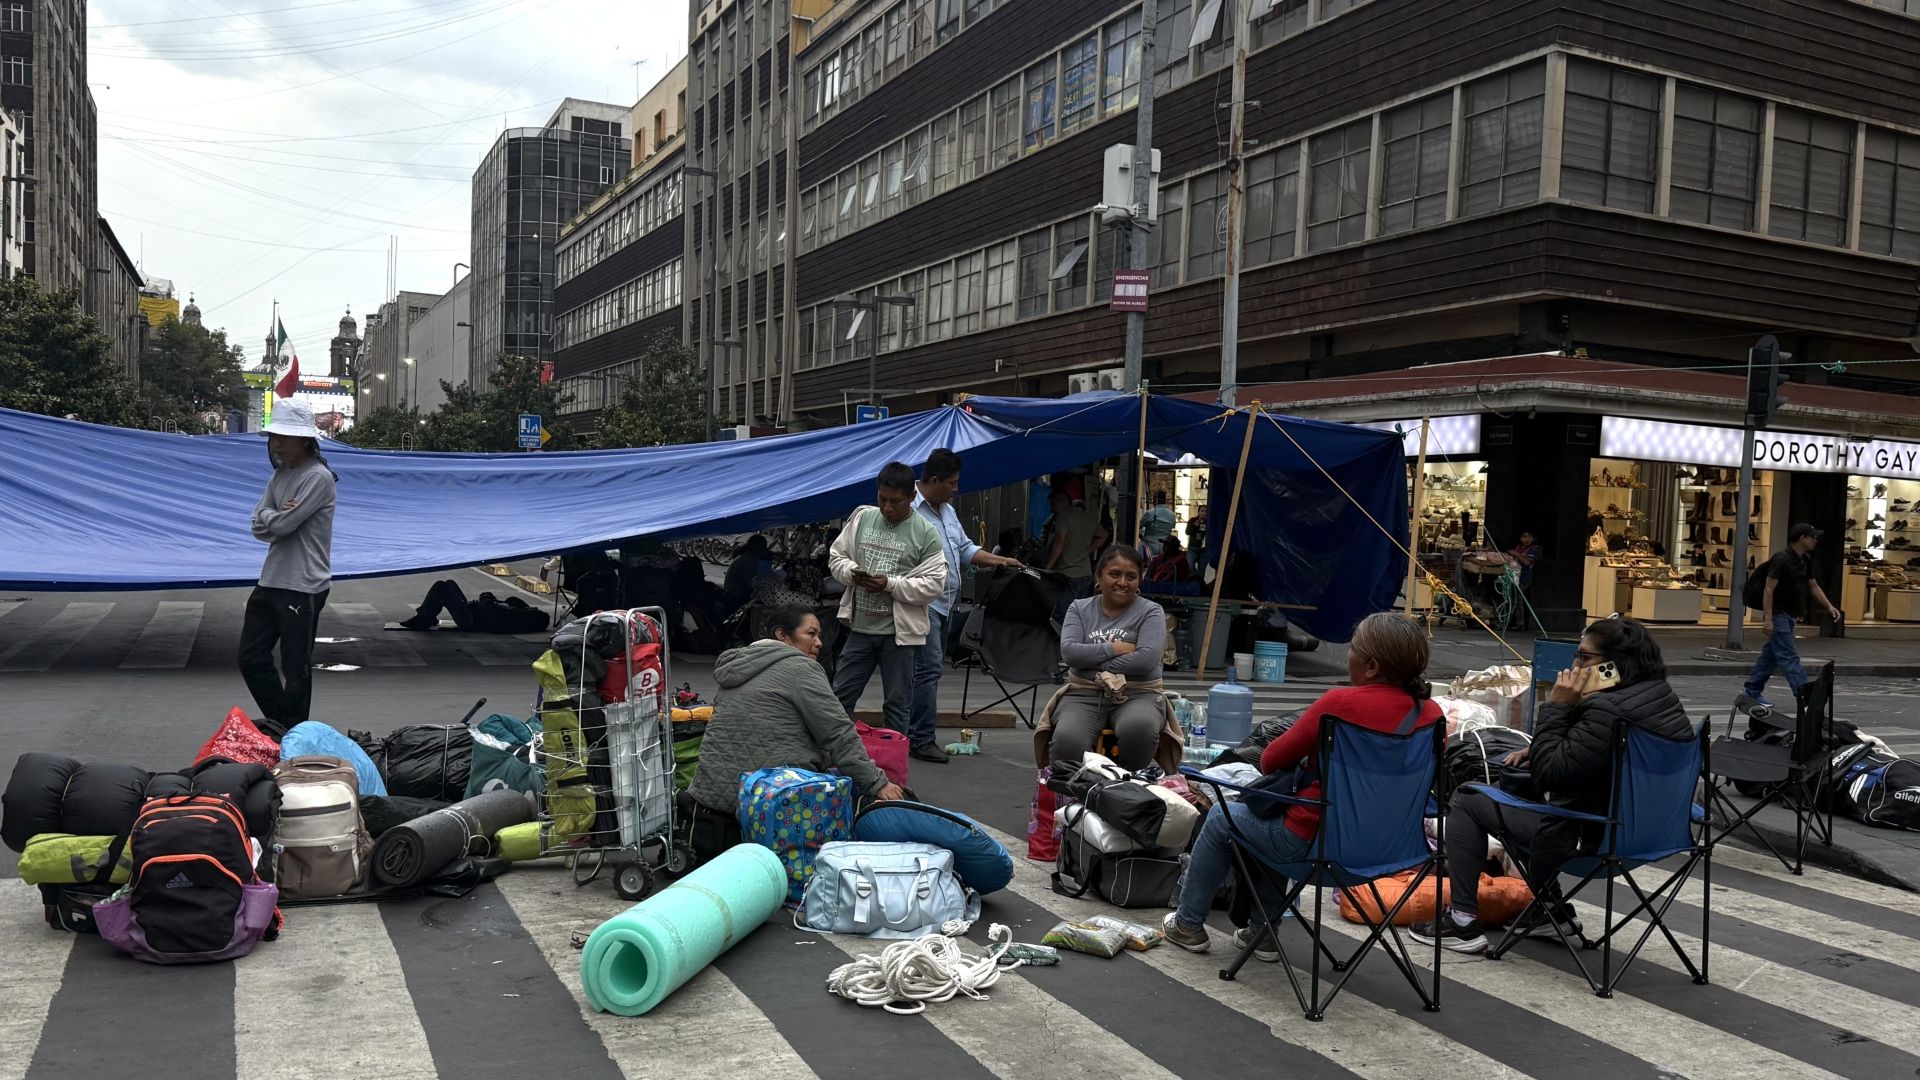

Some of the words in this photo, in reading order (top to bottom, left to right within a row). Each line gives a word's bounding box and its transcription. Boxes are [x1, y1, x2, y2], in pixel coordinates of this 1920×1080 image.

[1753, 439, 1865, 467] DOROTHY
[1875, 448, 1917, 471] GAY
[1106, 628, 1128, 638] ACTIVE
[641, 672, 652, 687] B
